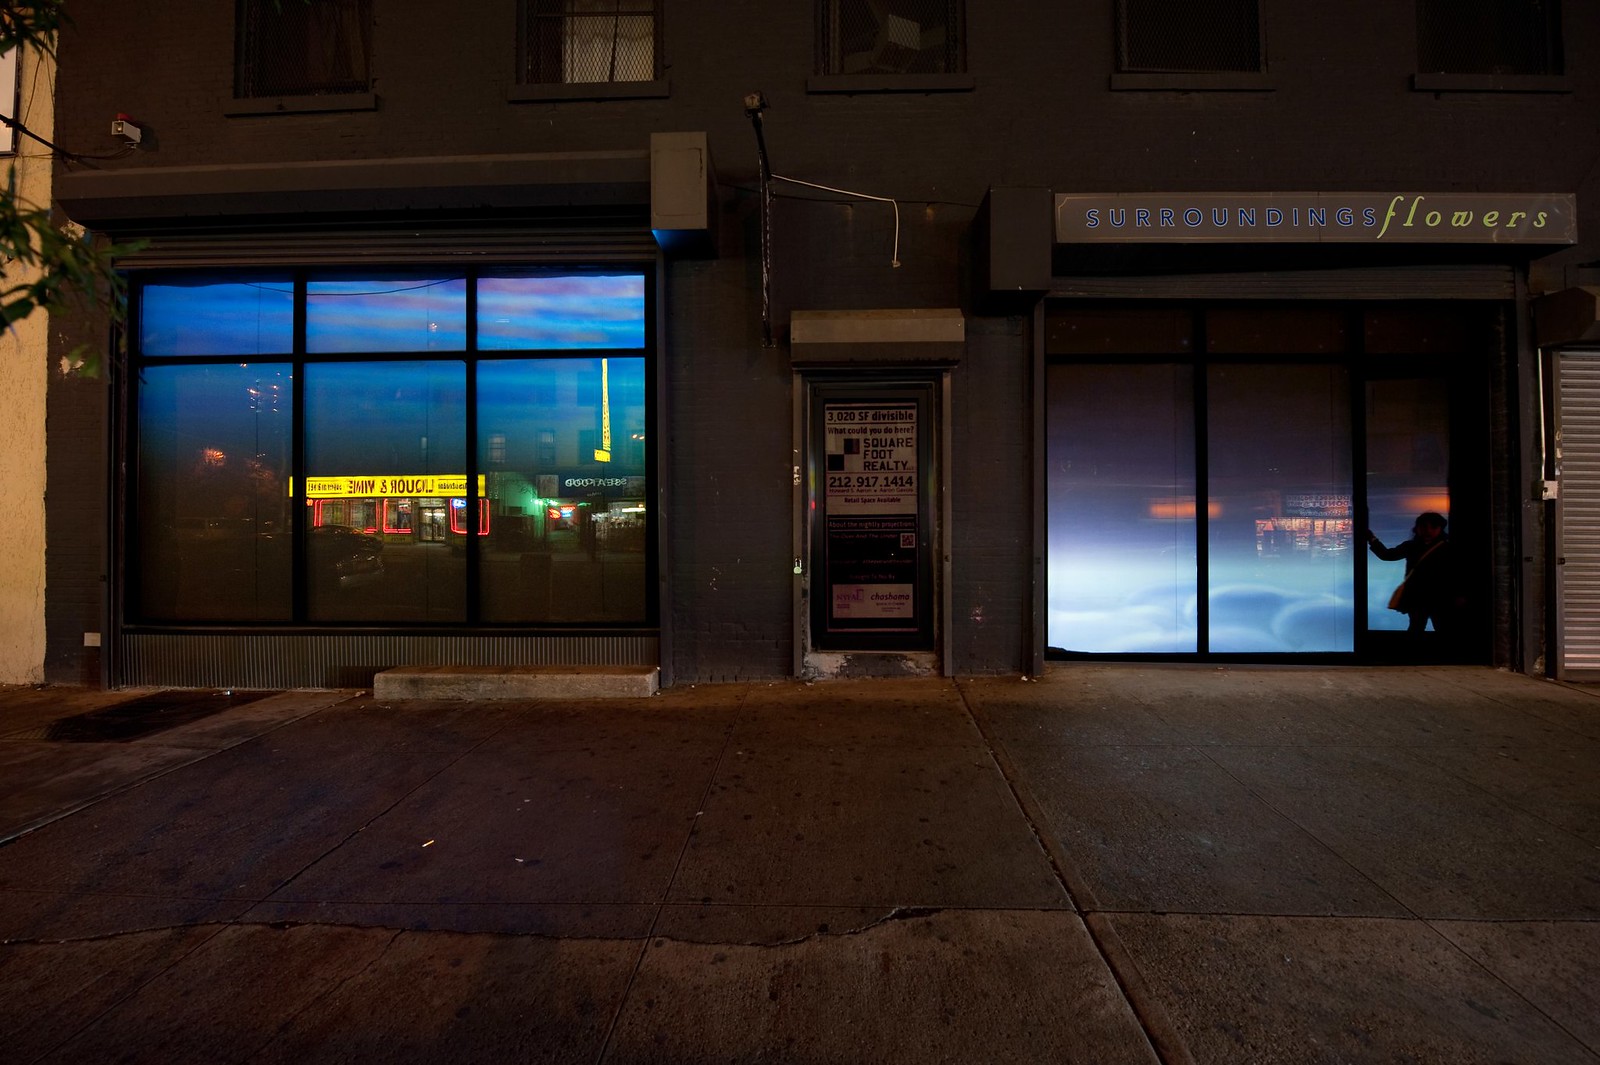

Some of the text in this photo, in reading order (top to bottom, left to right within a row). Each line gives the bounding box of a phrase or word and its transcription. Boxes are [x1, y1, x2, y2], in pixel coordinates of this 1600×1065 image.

[1085, 194, 1549, 240] SURROUNDINGS flowers
[827, 411, 914, 423] 3,020 SF divisible
[828, 426, 914, 436] What could you do here?
[863, 437, 913, 448] SQUARE
[863, 449, 894, 460] FOOT
[863, 460, 908, 471] REALTY
[829, 475, 914, 488] 212.917.1414
